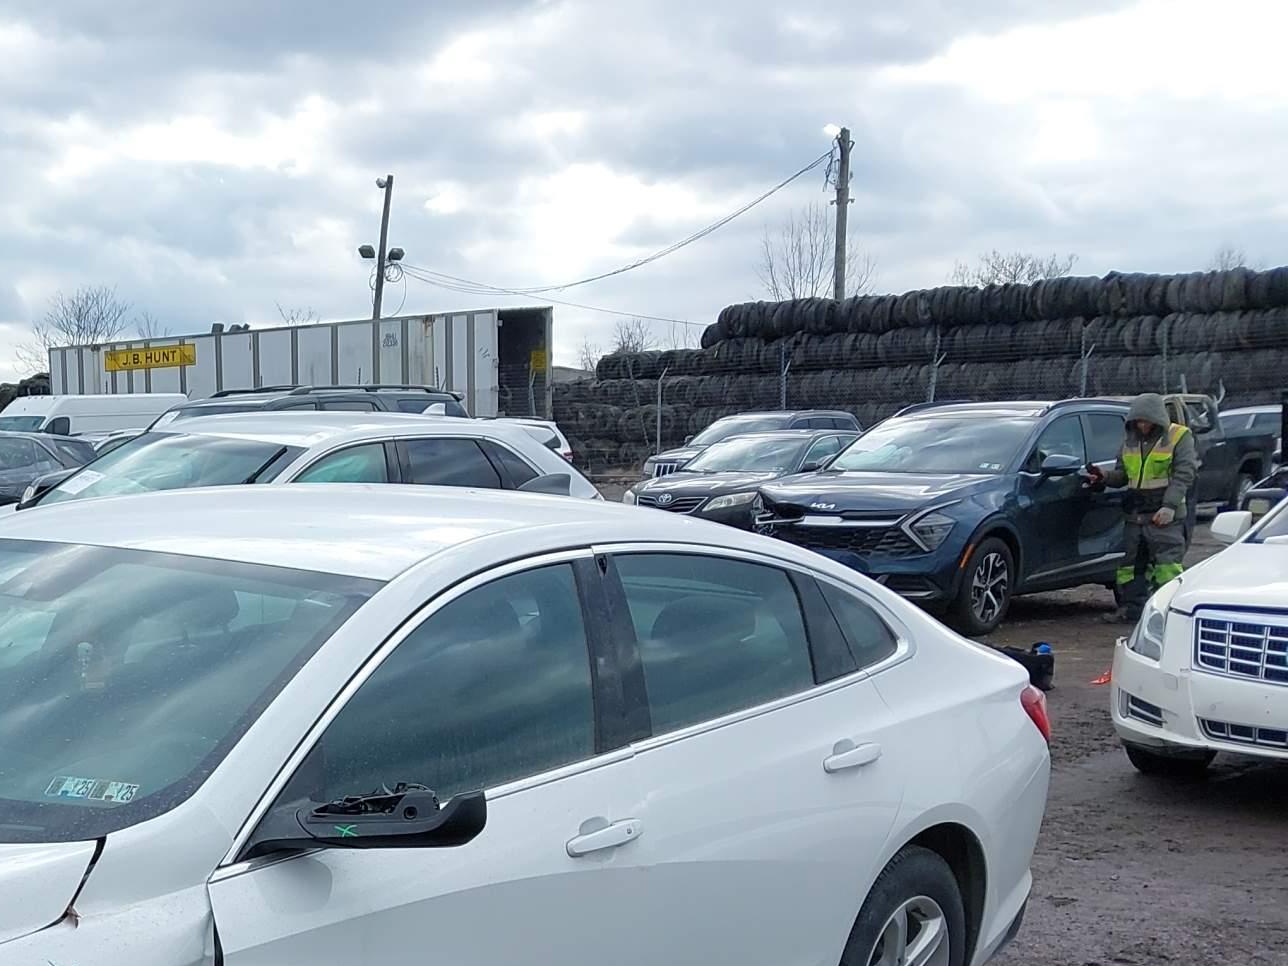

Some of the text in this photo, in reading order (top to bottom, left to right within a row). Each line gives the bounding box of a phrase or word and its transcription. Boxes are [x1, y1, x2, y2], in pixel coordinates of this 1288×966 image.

[122, 350, 177, 366] J.B. HUNT
[77, 780, 93, 796] 25
[120, 785, 137, 801] 25
